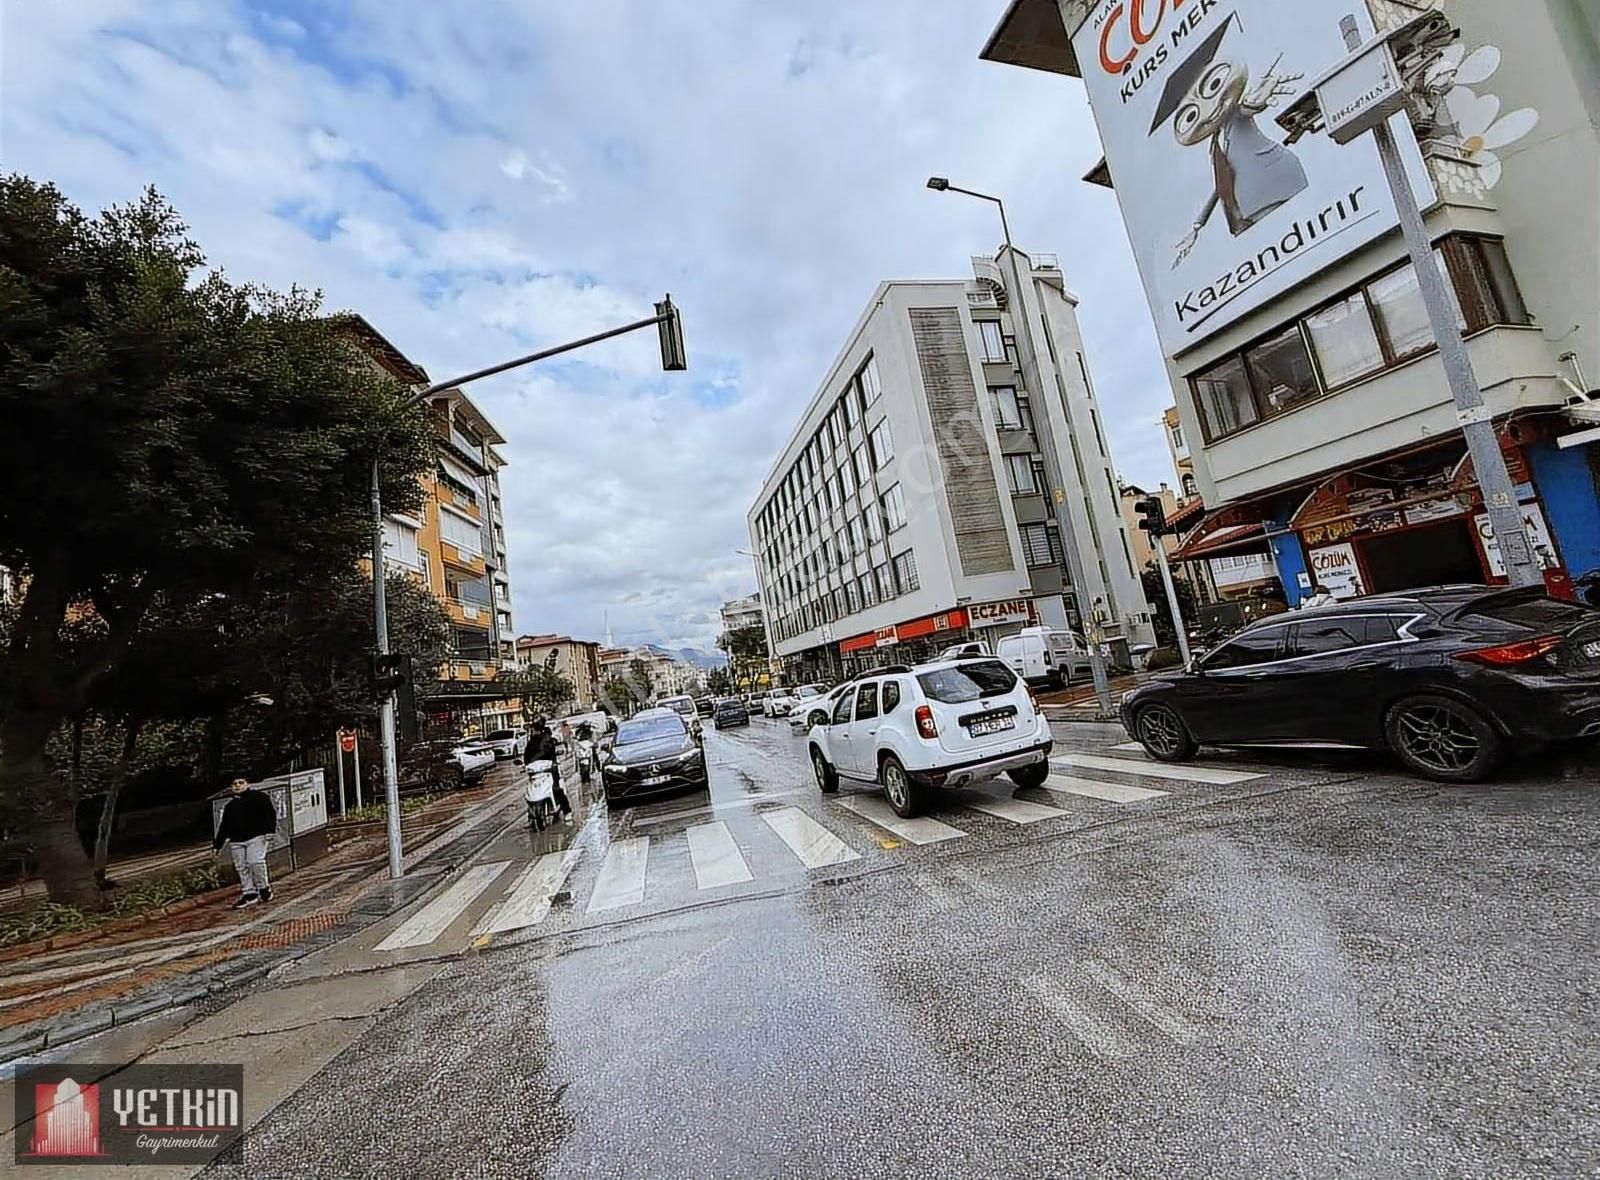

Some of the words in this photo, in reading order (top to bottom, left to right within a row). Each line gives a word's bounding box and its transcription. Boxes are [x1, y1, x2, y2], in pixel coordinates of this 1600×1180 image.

[1120, 42, 1168, 104] KURS
[1175, 185, 1364, 322] Kazandırır
[970, 600, 1027, 620] ECZANE
